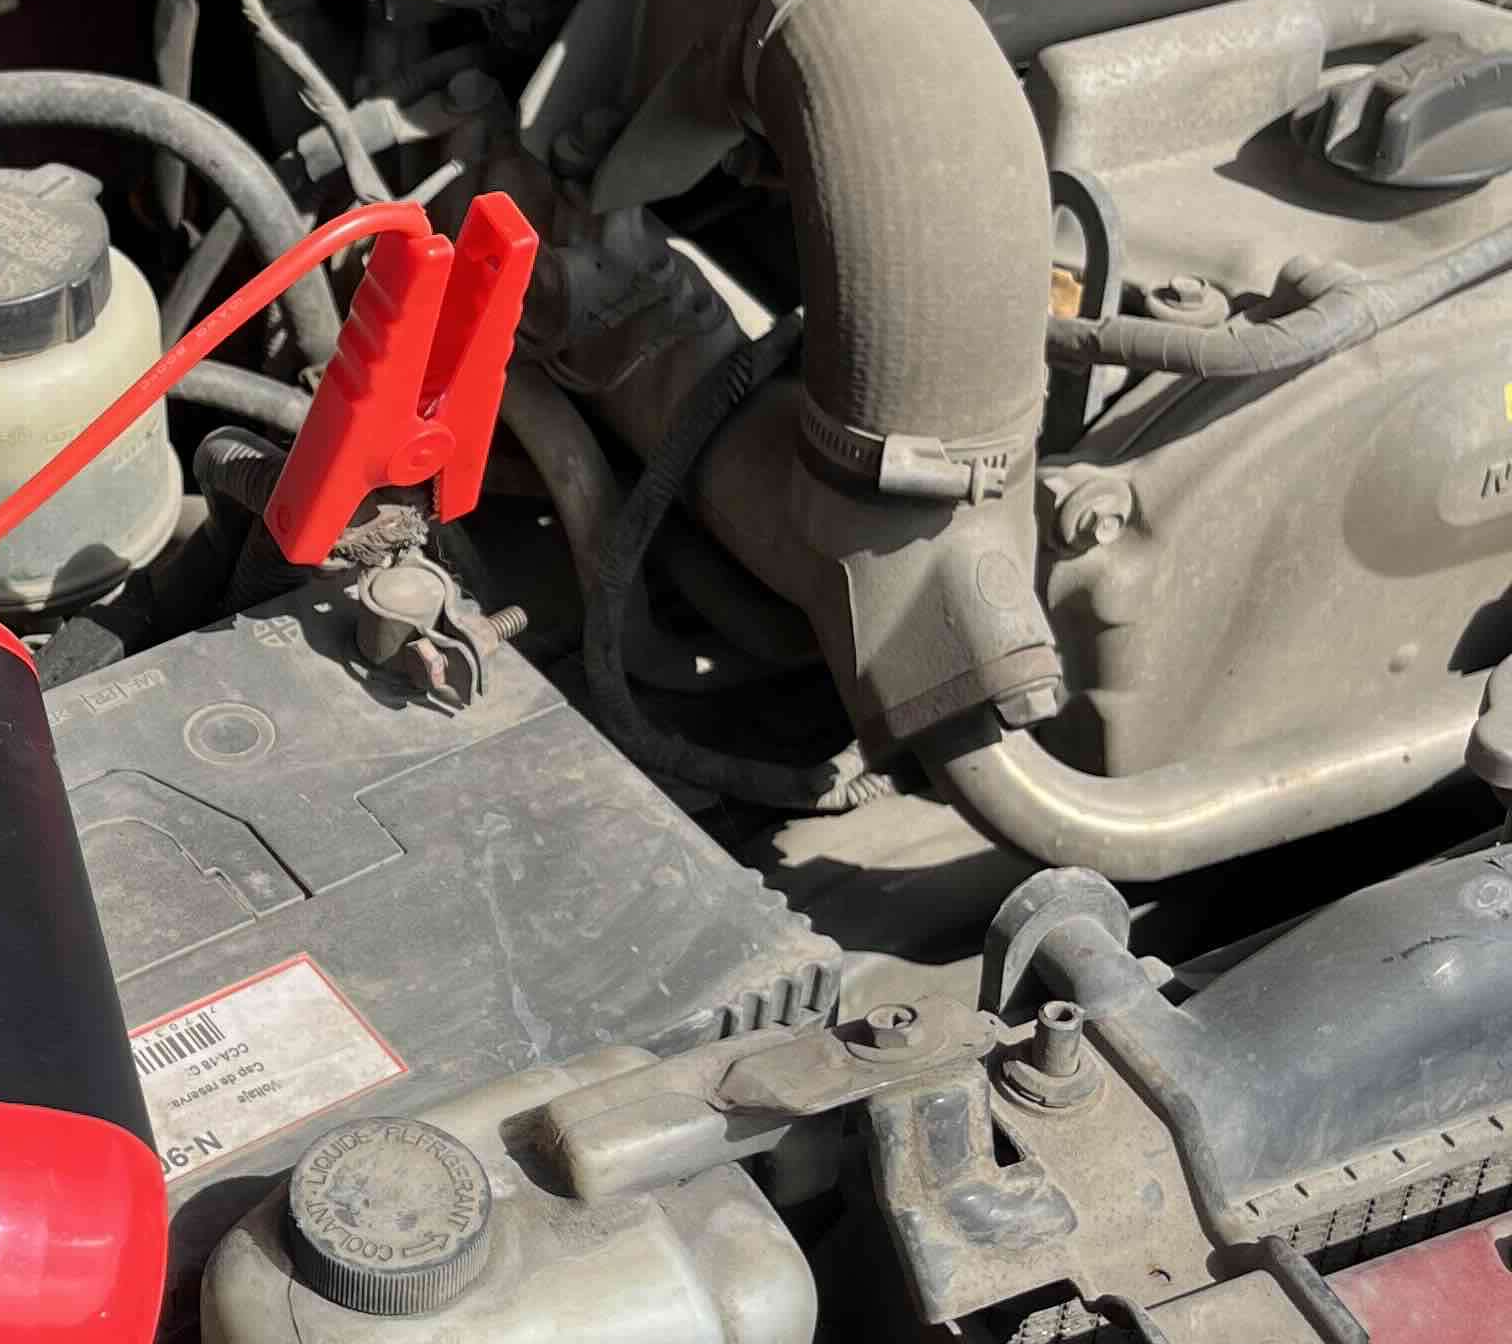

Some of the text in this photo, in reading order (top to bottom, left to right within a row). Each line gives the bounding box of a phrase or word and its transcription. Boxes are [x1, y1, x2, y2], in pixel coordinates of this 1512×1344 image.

[220, 1074, 237, 1085] de
[238, 1062, 264, 1077] Cap
[237, 1079, 280, 1104] Voltaje
[304, 1130, 374, 1186] LIQUIDE
[304, 1198, 393, 1262] COOLANT
